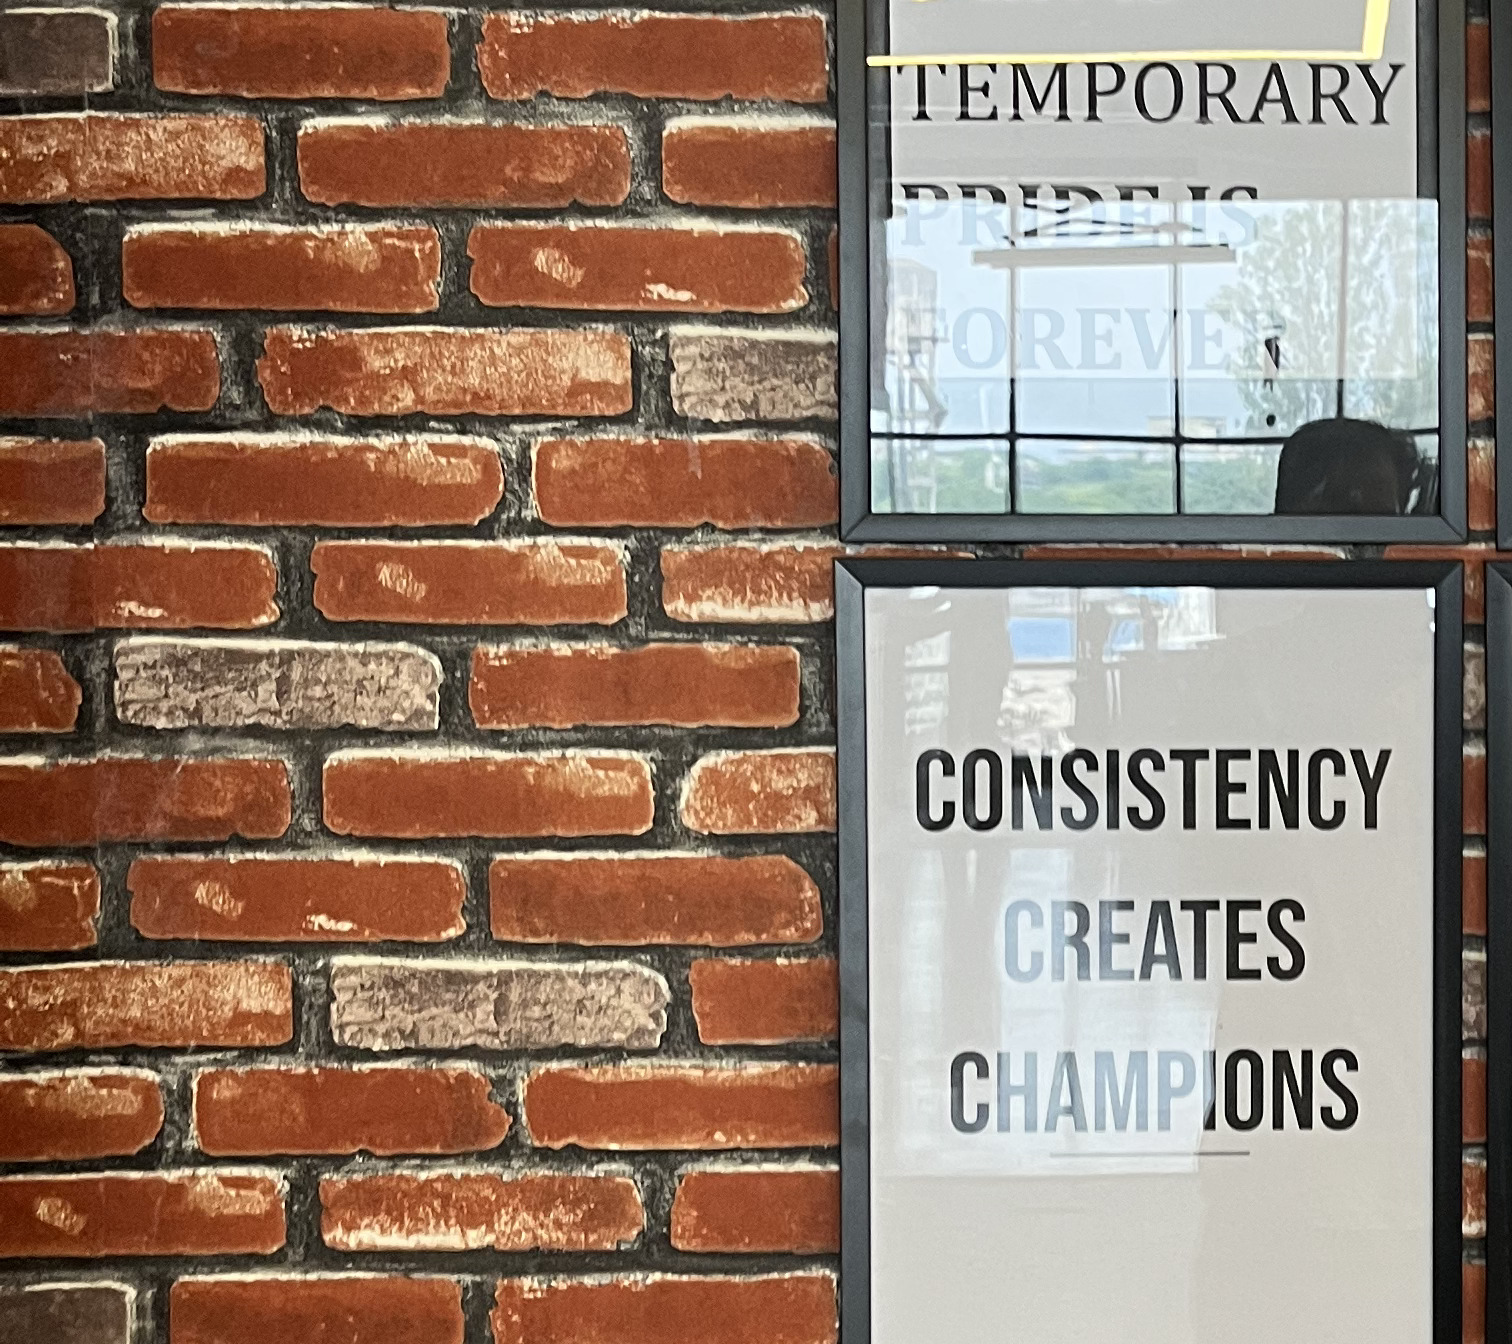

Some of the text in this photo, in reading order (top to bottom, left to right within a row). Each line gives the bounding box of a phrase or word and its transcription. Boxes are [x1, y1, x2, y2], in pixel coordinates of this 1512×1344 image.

[896, 61, 1404, 126] TEMPORARY
[900, 183, 1260, 248] PRIDE IS
[914, 747, 1393, 832] CONSISTENCY
[1003, 898, 1307, 982] CREATES
[950, 1048, 1360, 1134] CHAMPIONS
